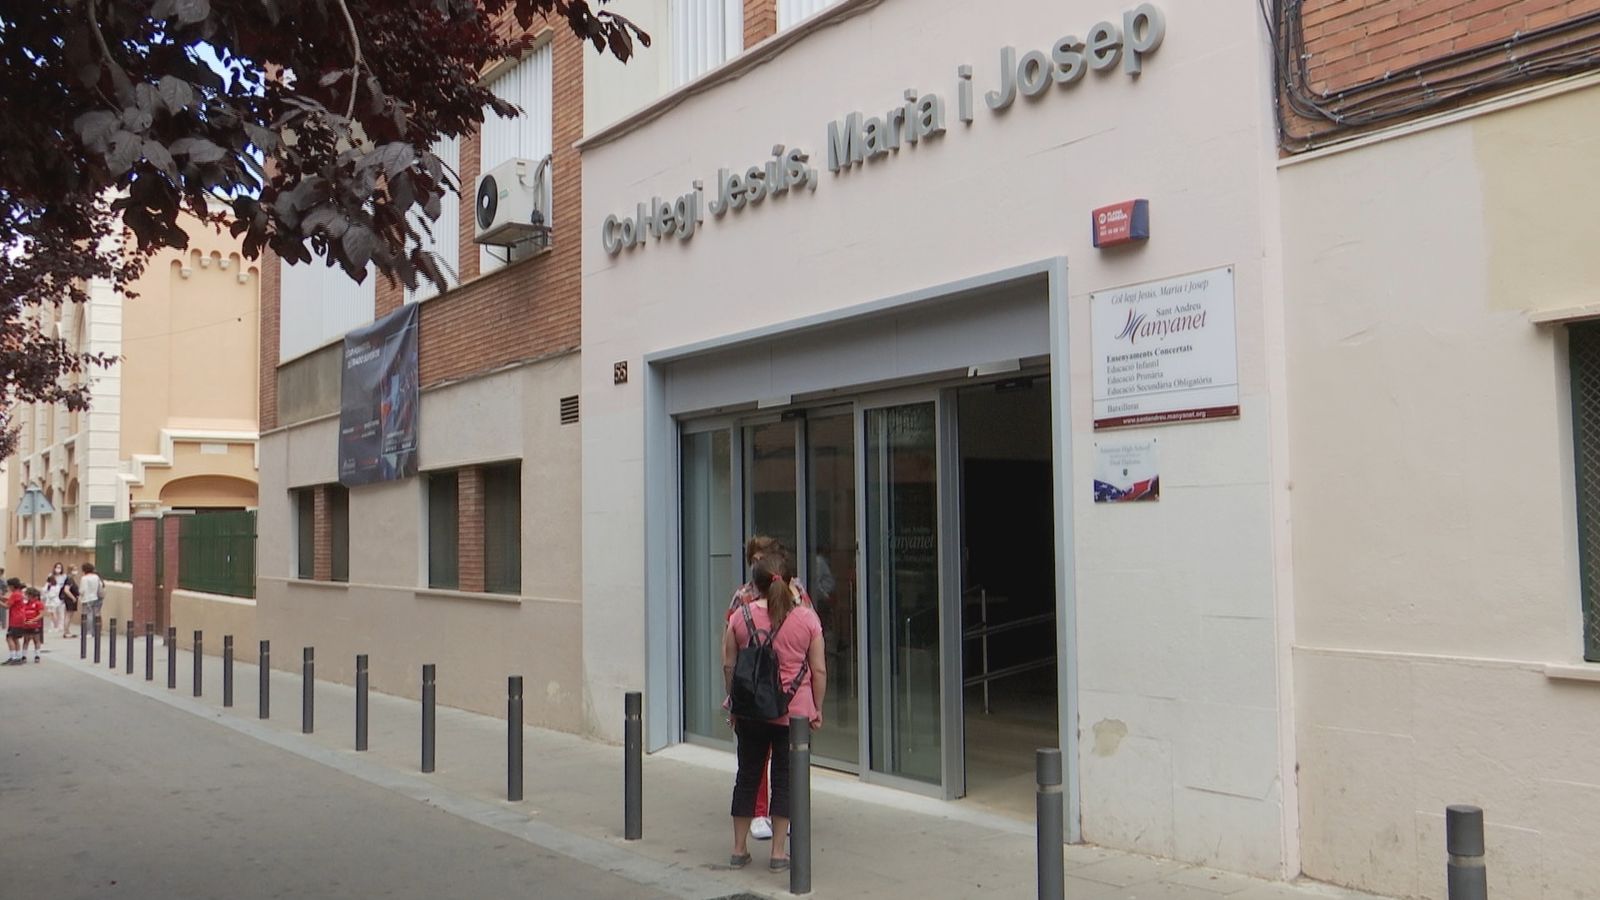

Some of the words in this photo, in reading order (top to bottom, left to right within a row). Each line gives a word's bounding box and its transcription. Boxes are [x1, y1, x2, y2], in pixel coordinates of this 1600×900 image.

[708, 143, 818, 217] Jesús,
[827, 88, 947, 173] Maria
[957, 64, 974, 125] i
[984, 2, 1166, 110] Josep
[1160, 285, 1182, 297] Maria
[1189, 279, 1209, 294] Josep
[1156, 307, 1172, 317] Sant
[1174, 302, 1202, 314] Andreu
[1114, 308, 1207, 344] Manyanet
[1107, 351, 1153, 363] Ensenyaments
[1154, 344, 1193, 357] Concertats
[615, 362, 627, 380] 55
[1136, 359, 1159, 369] Infantil
